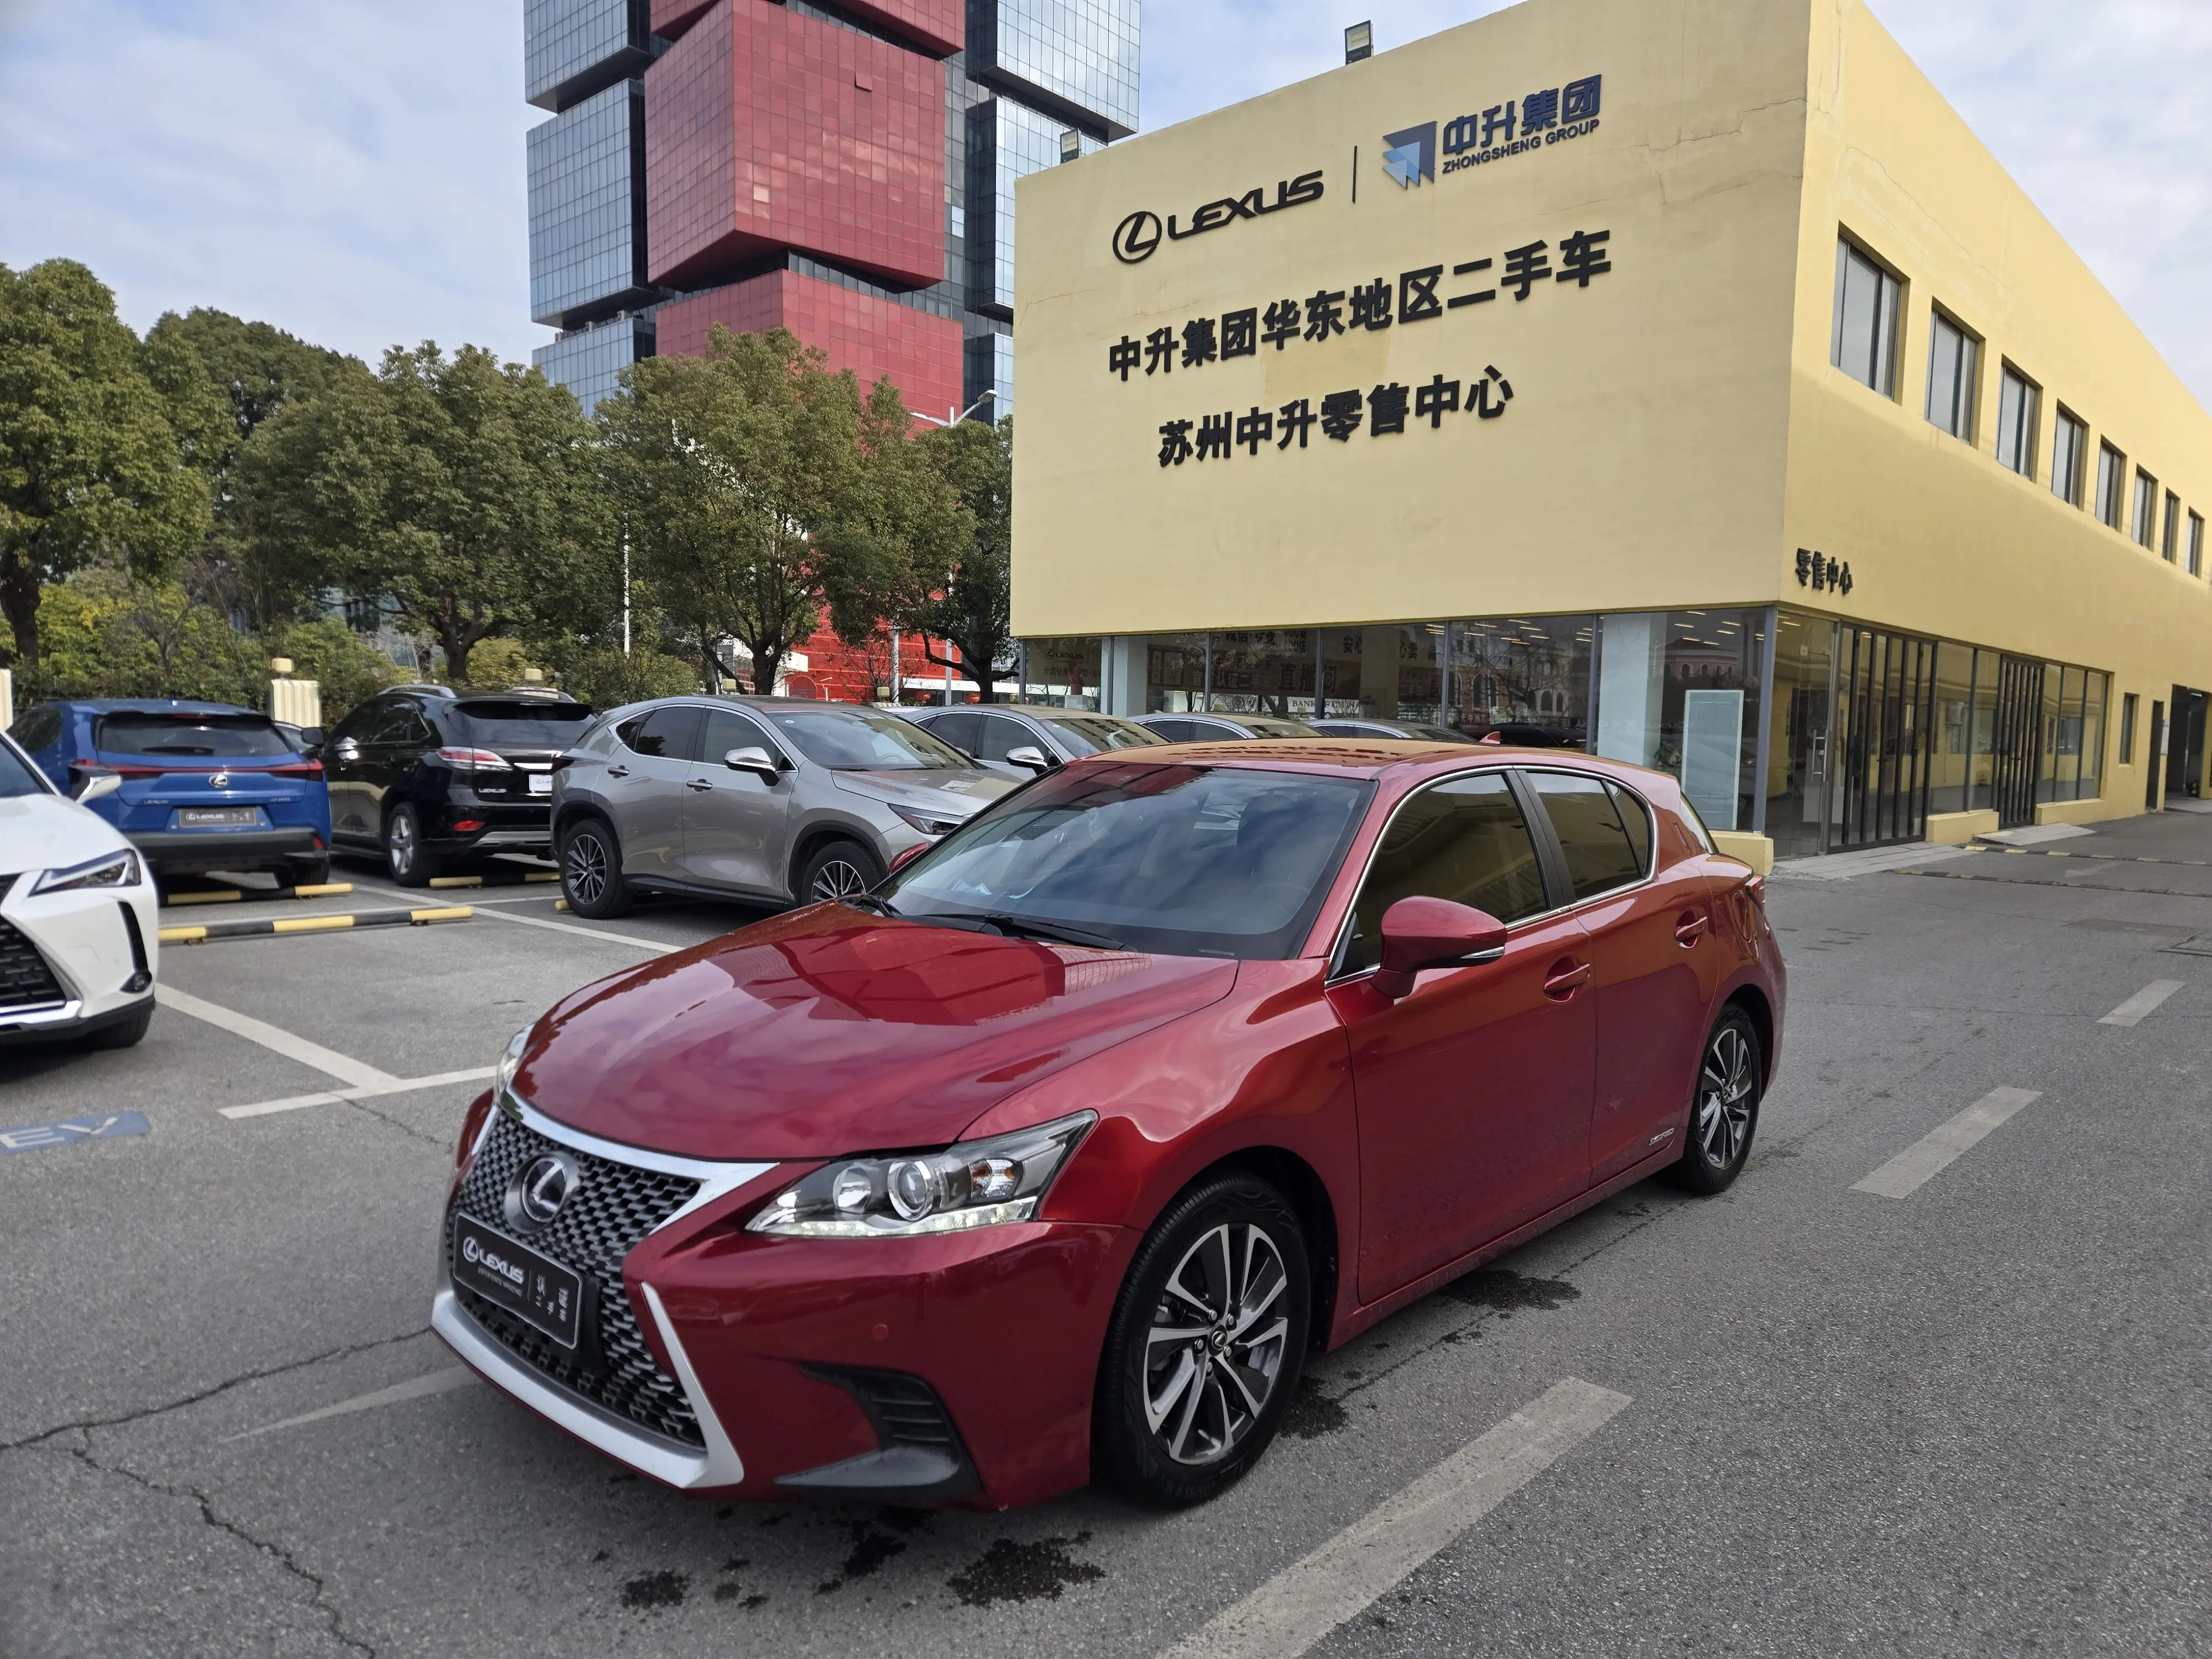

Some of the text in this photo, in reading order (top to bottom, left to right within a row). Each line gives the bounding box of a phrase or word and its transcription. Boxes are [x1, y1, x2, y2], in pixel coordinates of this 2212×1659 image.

[1442, 74, 1602, 156] 中升集团
[1442, 119, 1600, 174] ZHONGSHENG GROUP
[1167, 170, 1324, 241] LEXUS
[1109, 229, 1611, 382] 中升集团华东地区二手车
[1157, 364, 1514, 468] 苏州中升零售中心
[1795, 547, 1853, 595] 零售中心
[1292, 700, 1316, 708] BANK
[479, 1248, 524, 1285] LEXUS
